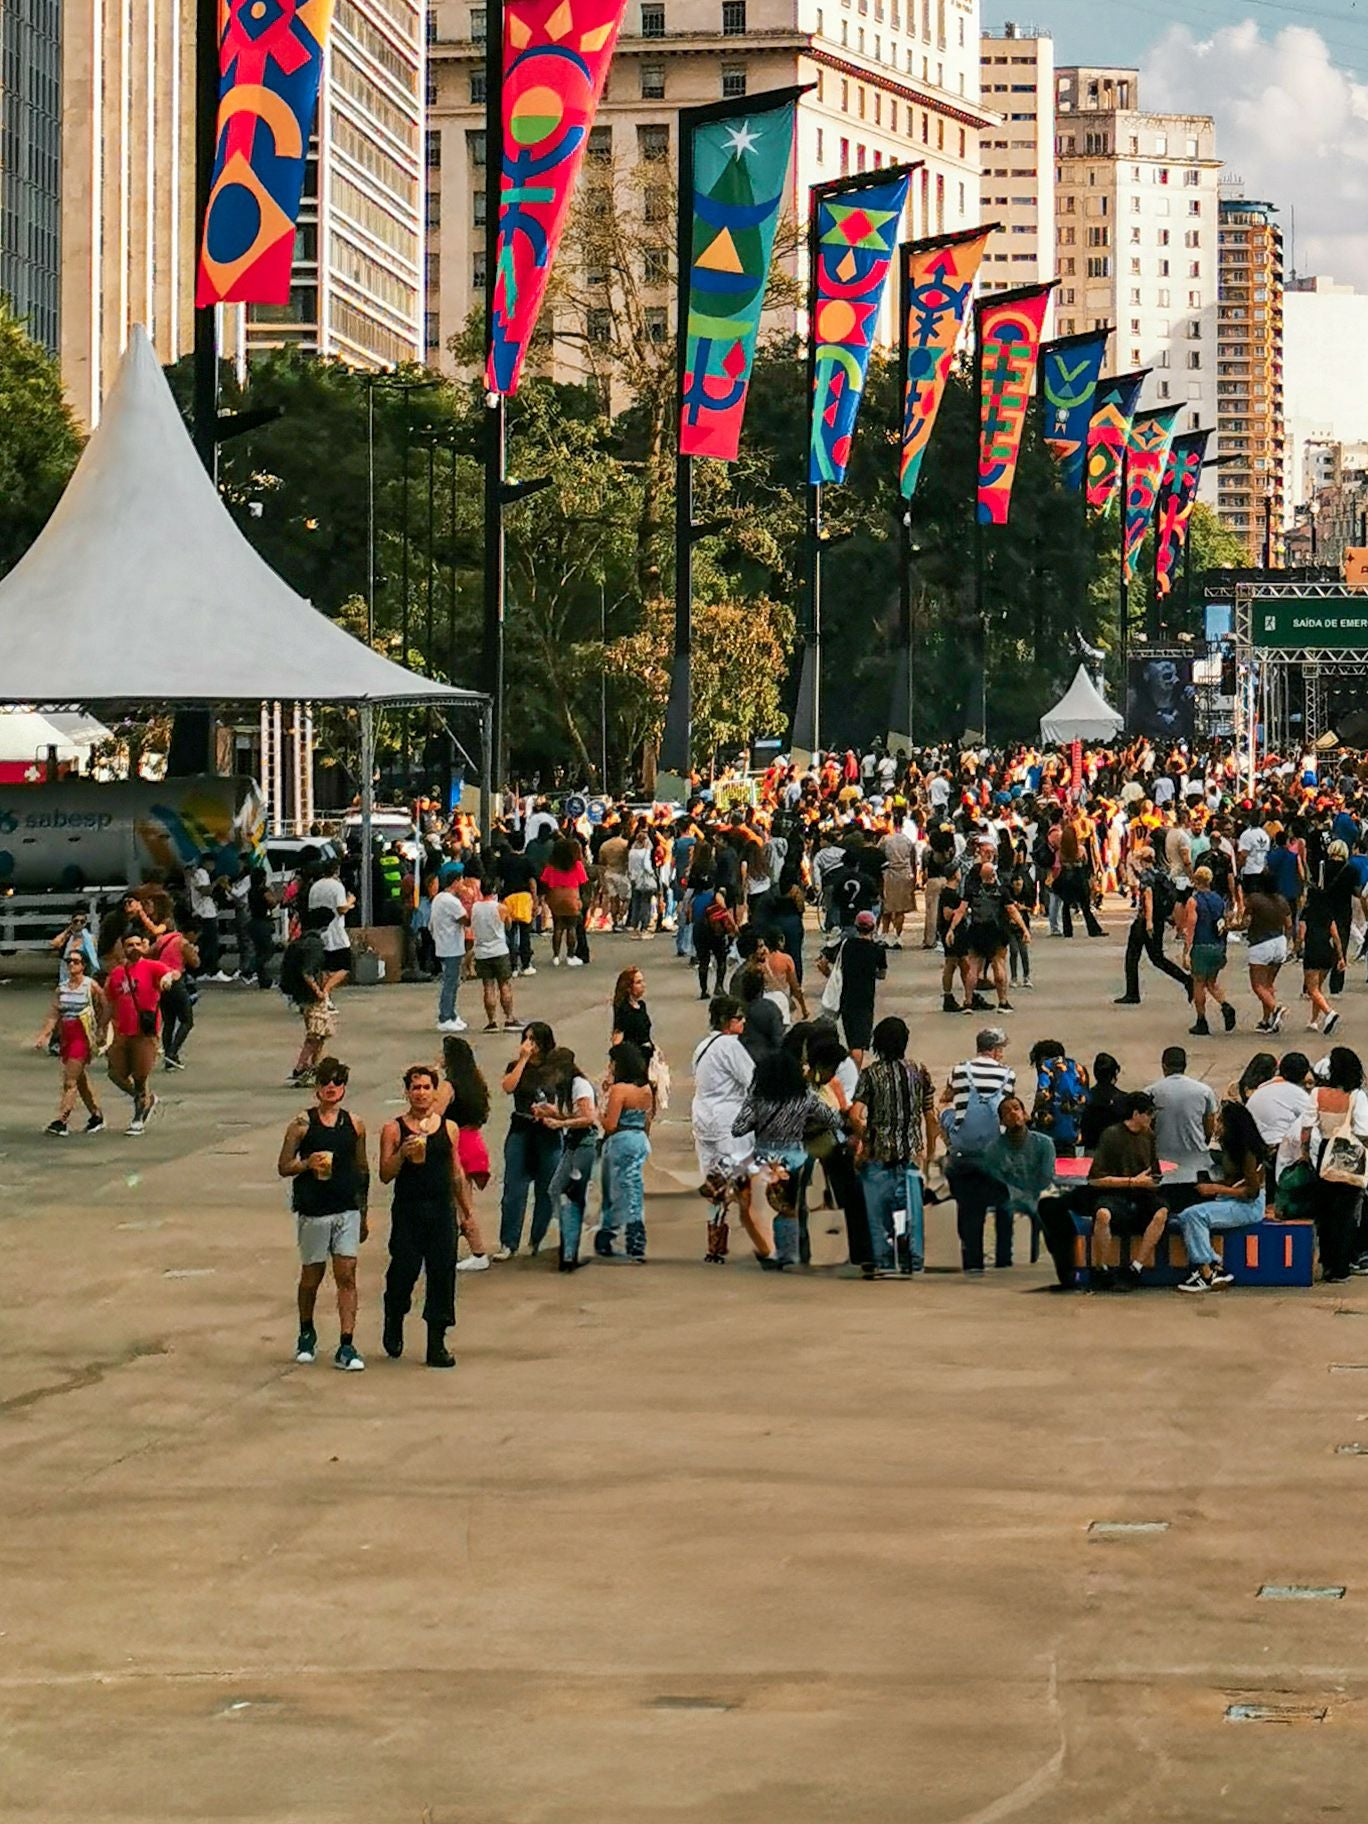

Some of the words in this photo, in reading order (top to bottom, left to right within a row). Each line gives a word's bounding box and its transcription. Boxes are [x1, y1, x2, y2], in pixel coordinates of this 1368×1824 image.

[1293, 617, 1322, 628] SAÍDA
[1325, 619, 1338, 628] DE
[25, 809, 112, 831] sabesp
